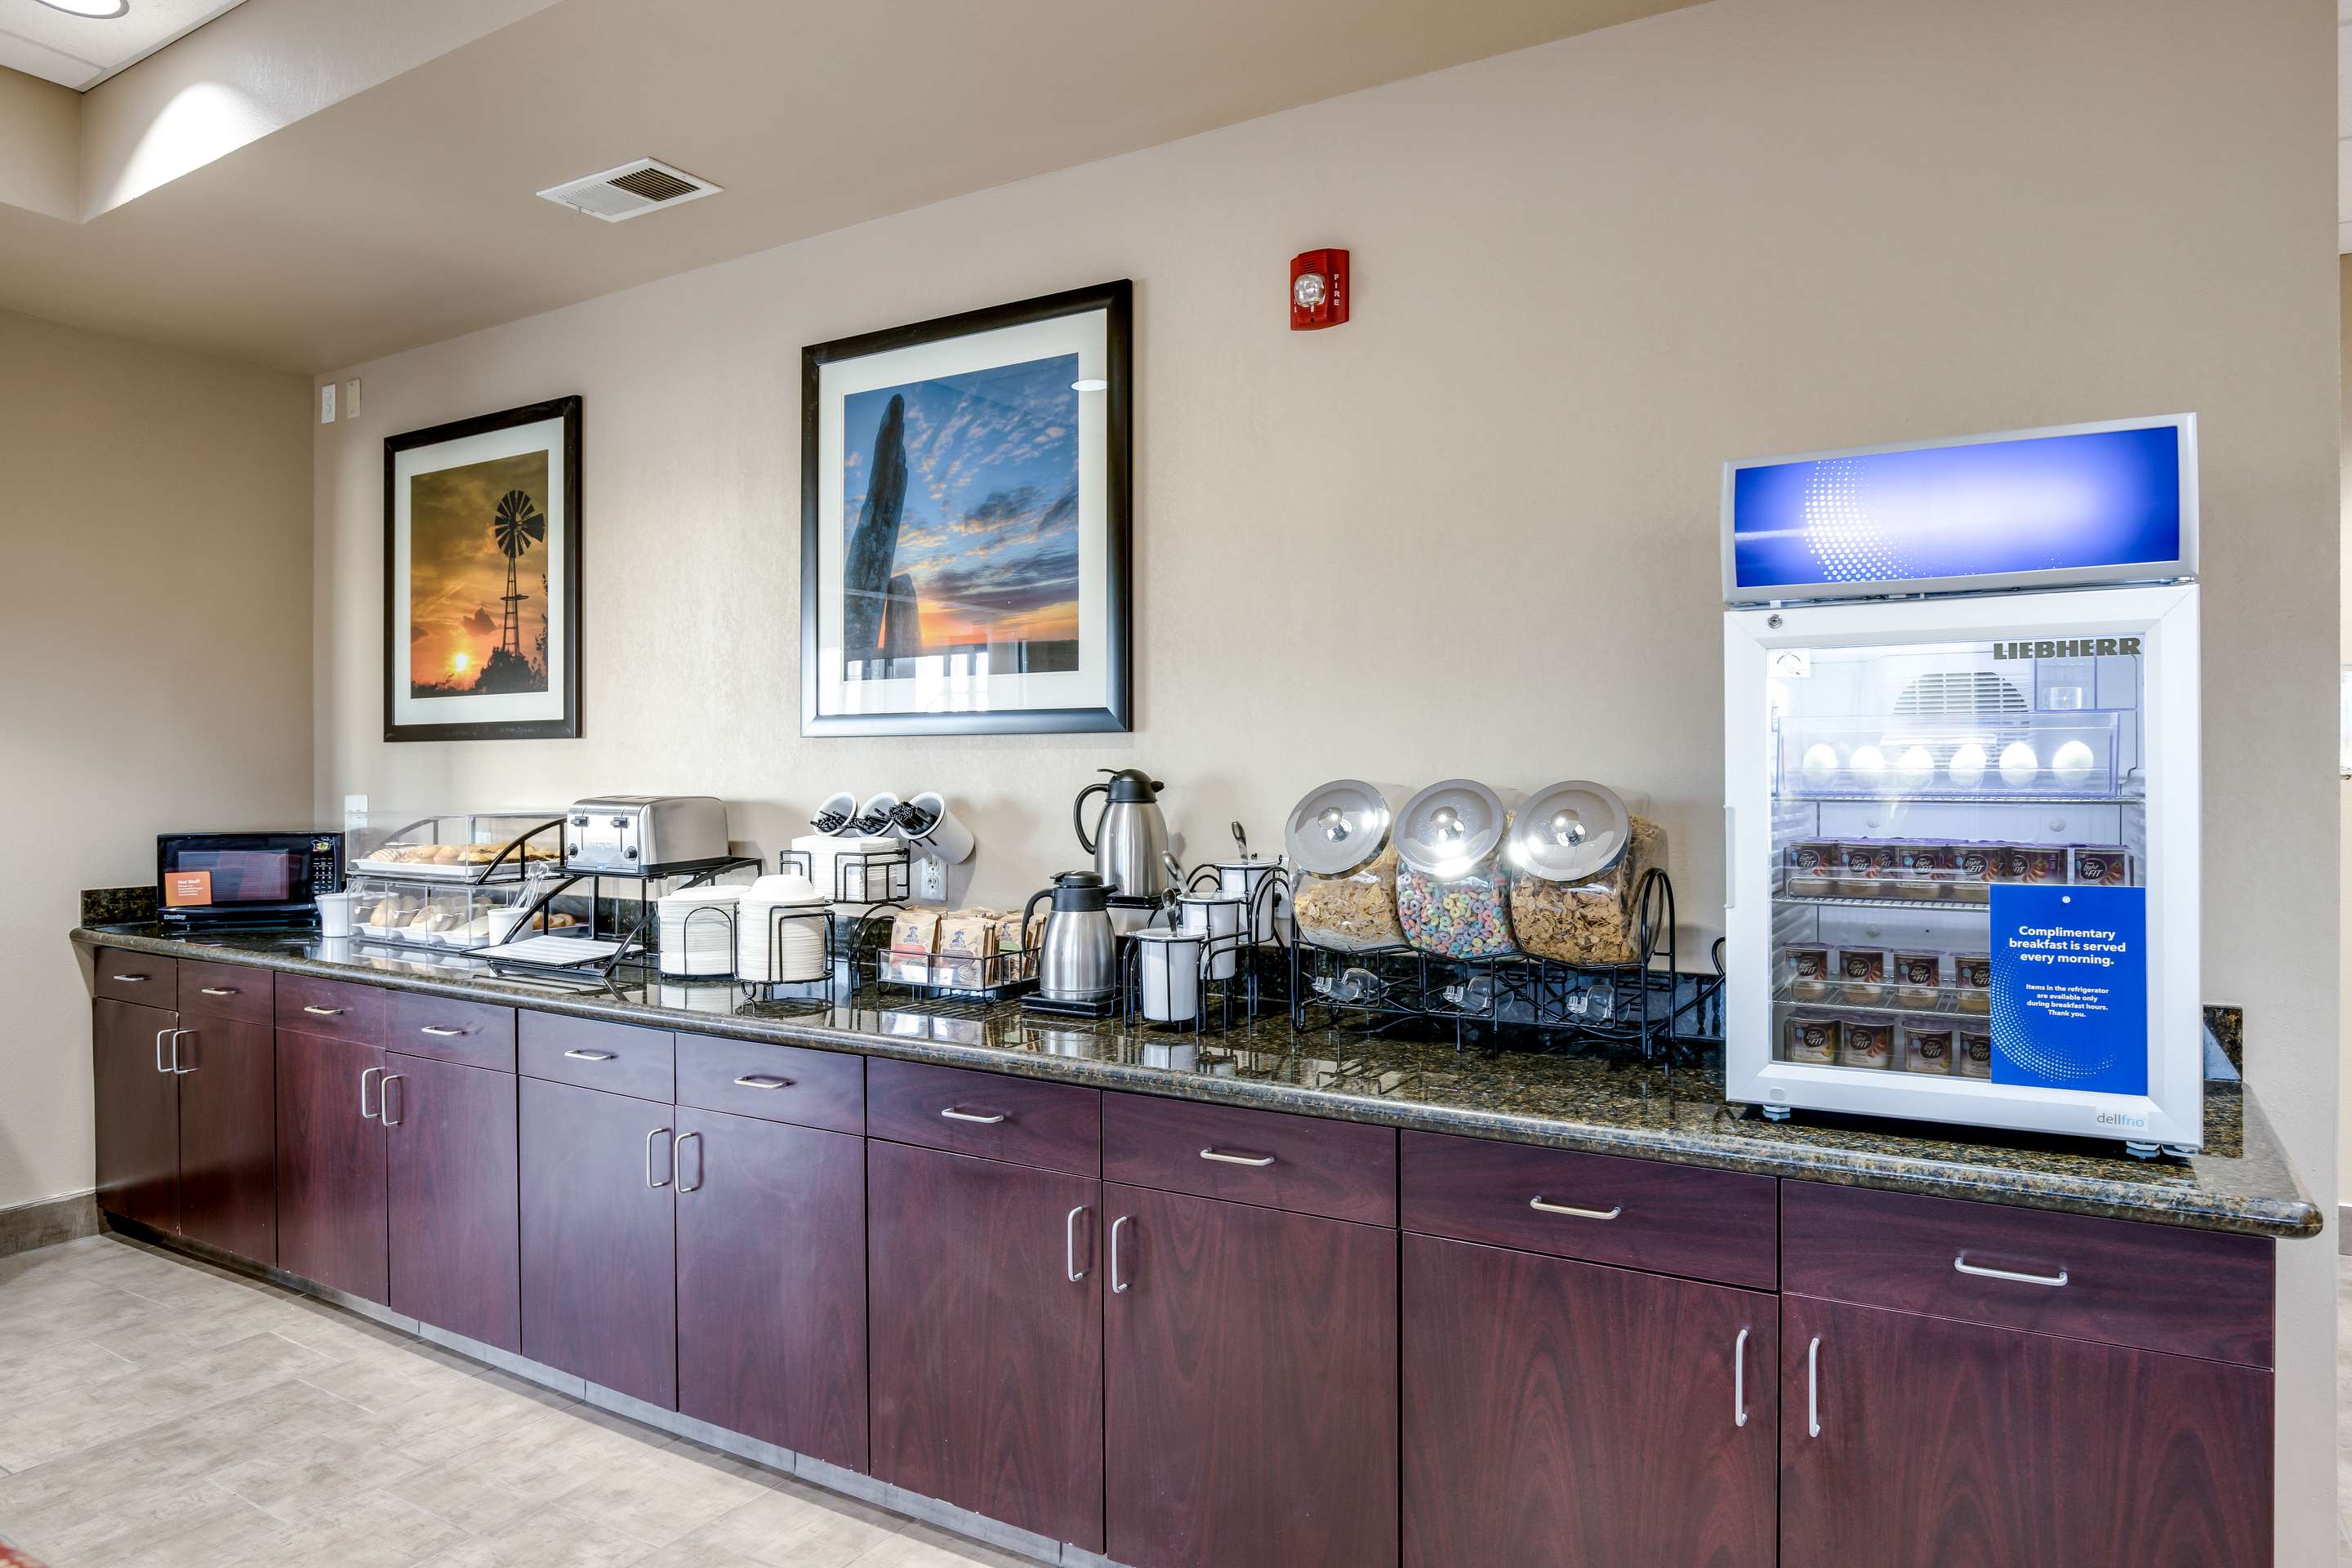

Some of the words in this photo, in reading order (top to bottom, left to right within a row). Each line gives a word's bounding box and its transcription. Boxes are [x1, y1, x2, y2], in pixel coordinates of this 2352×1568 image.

[1993, 637, 2141, 660] LIEBHERR
[2019, 925, 2116, 941] Complimentary
[2009, 938, 2068, 950] breakfast
[2070, 941, 2080, 950] is
[2082, 942, 2126, 952] served
[2020, 953, 2055, 964] every
[2057, 954, 2114, 967] morning.
[2026, 1000, 2050, 1009] during
[2051, 1001, 2085, 1009] breakfast
[2096, 1112, 2144, 1127] dellfrio
